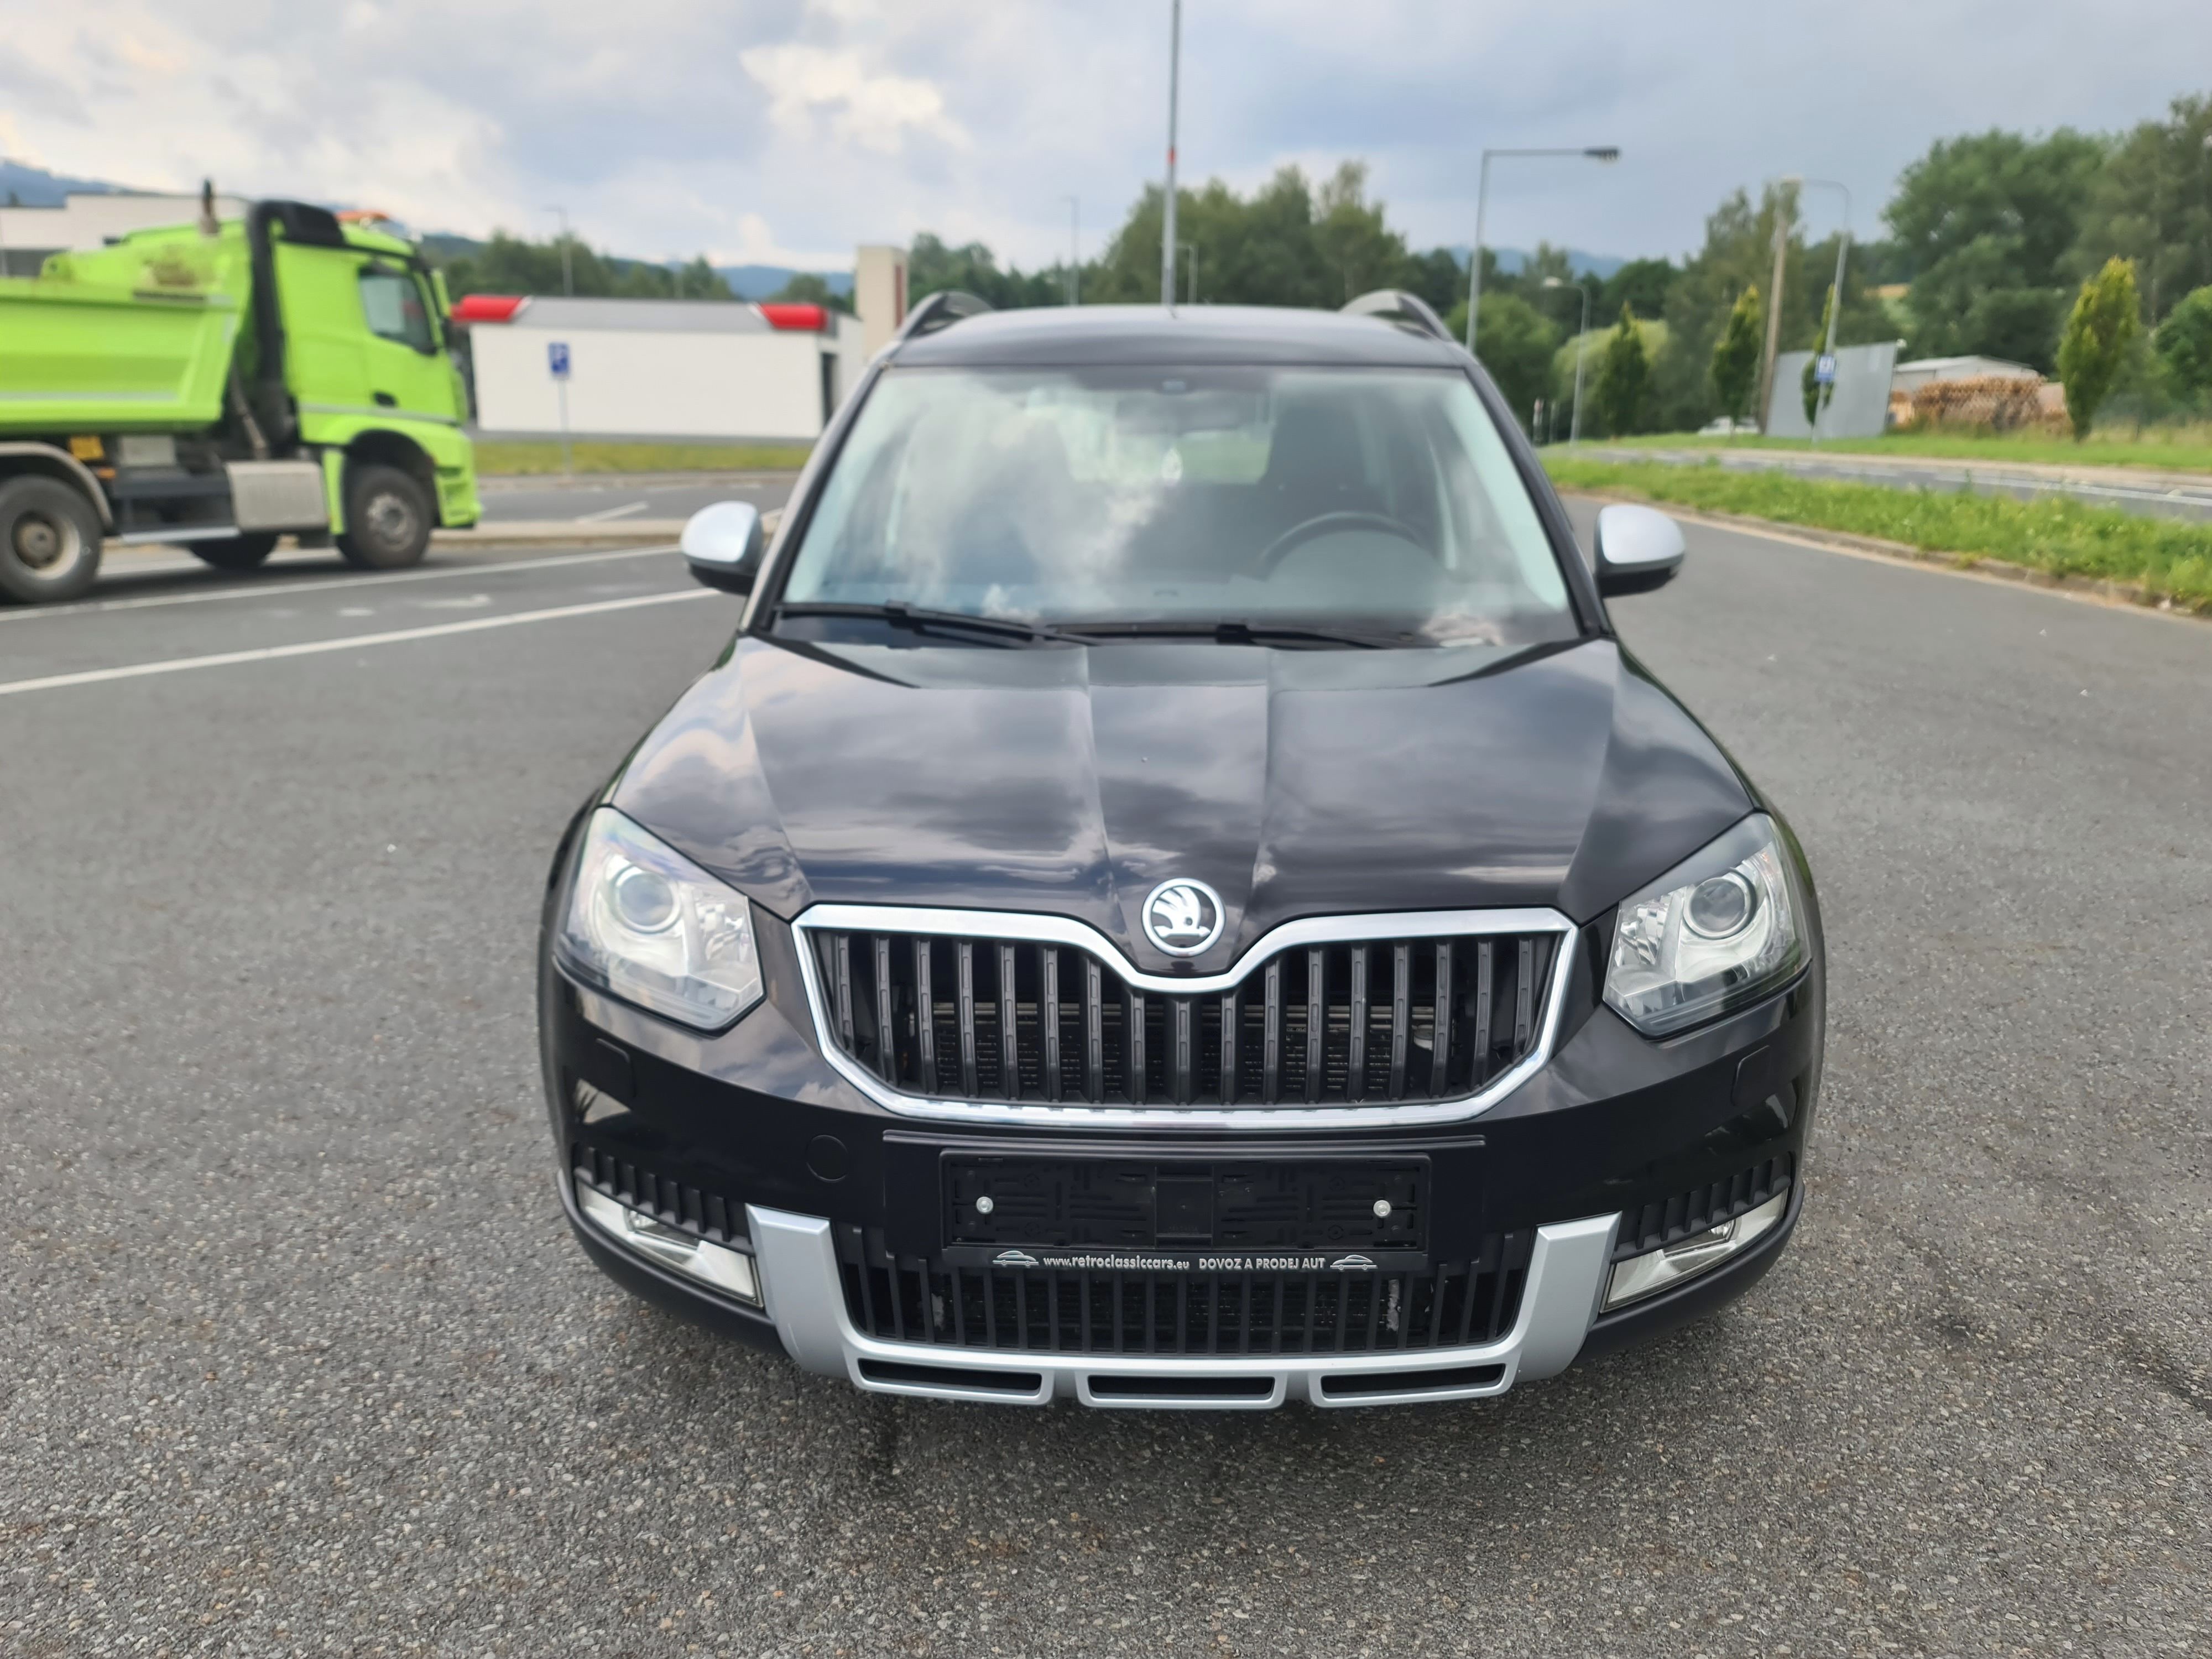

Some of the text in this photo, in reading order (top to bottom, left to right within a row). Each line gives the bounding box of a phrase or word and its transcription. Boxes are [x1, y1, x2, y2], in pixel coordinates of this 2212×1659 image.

[1043, 1254, 1326, 1270] www.retroclassiccars.eu DOVOZ A PRODEJ AUT
